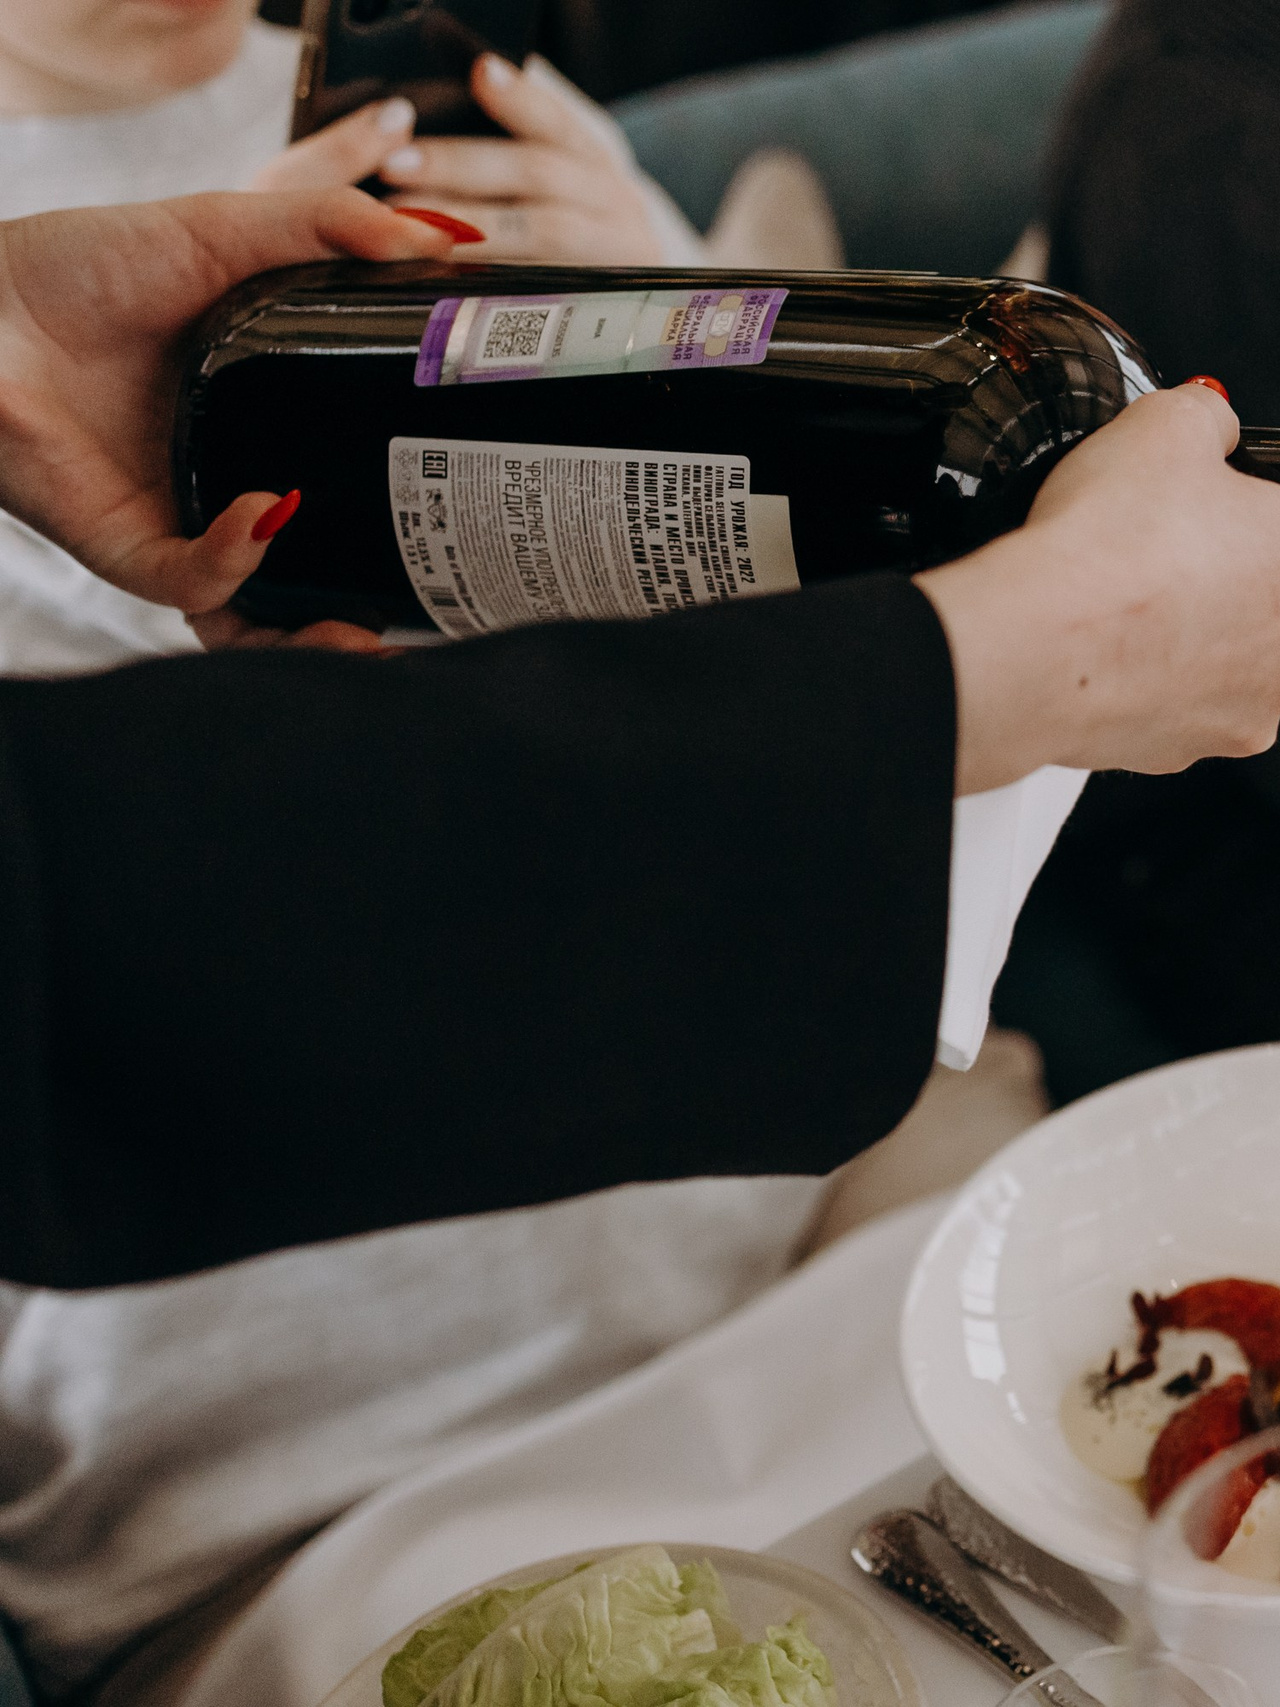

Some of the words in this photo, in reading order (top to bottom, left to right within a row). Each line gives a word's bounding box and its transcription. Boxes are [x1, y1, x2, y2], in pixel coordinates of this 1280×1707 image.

[666, 310, 683, 342] МАРКА
[672, 295, 702, 361] СПЕЦИАЛЬНАЯ
[683, 295, 711, 360] ФЕДЕРАЛЬНАЯ
[731, 295, 758, 355] ФЕДЕРАЦИЯ
[742, 294, 770, 354] РОССИЙСКАЯ
[503, 460, 525, 530] ВРЕДИТ
[663, 463, 677, 507] СТРАНА
[681, 464, 691, 498] ТОСКАНА,
[693, 465, 702, 483] ВИНО
[704, 465, 713, 502] ФАТТОРИЯ
[715, 466, 724, 498] FATTORIA
[728, 467, 745, 489] ГОД
[524, 461, 546, 544] ЧРЕЗМЕРНОЕ
[682, 500, 694, 538] КАТЕГОРИЯ
[716, 501, 727, 542] SELVAPIANA
[624, 461, 650, 564] ВИНОДЕЛЬЧЕСКИЙ
[637, 569, 659, 604] РЕГИОН
[644, 463, 661, 534] ВИНОГРАДА:
[661, 593, 678, 610] ТОС
[666, 527, 685, 564] МЕСТО
[730, 501, 748, 552] УРОЖАЯ:
[510, 533, 542, 599] ВАШЕМУ
[737, 557, 755, 584] 2022
